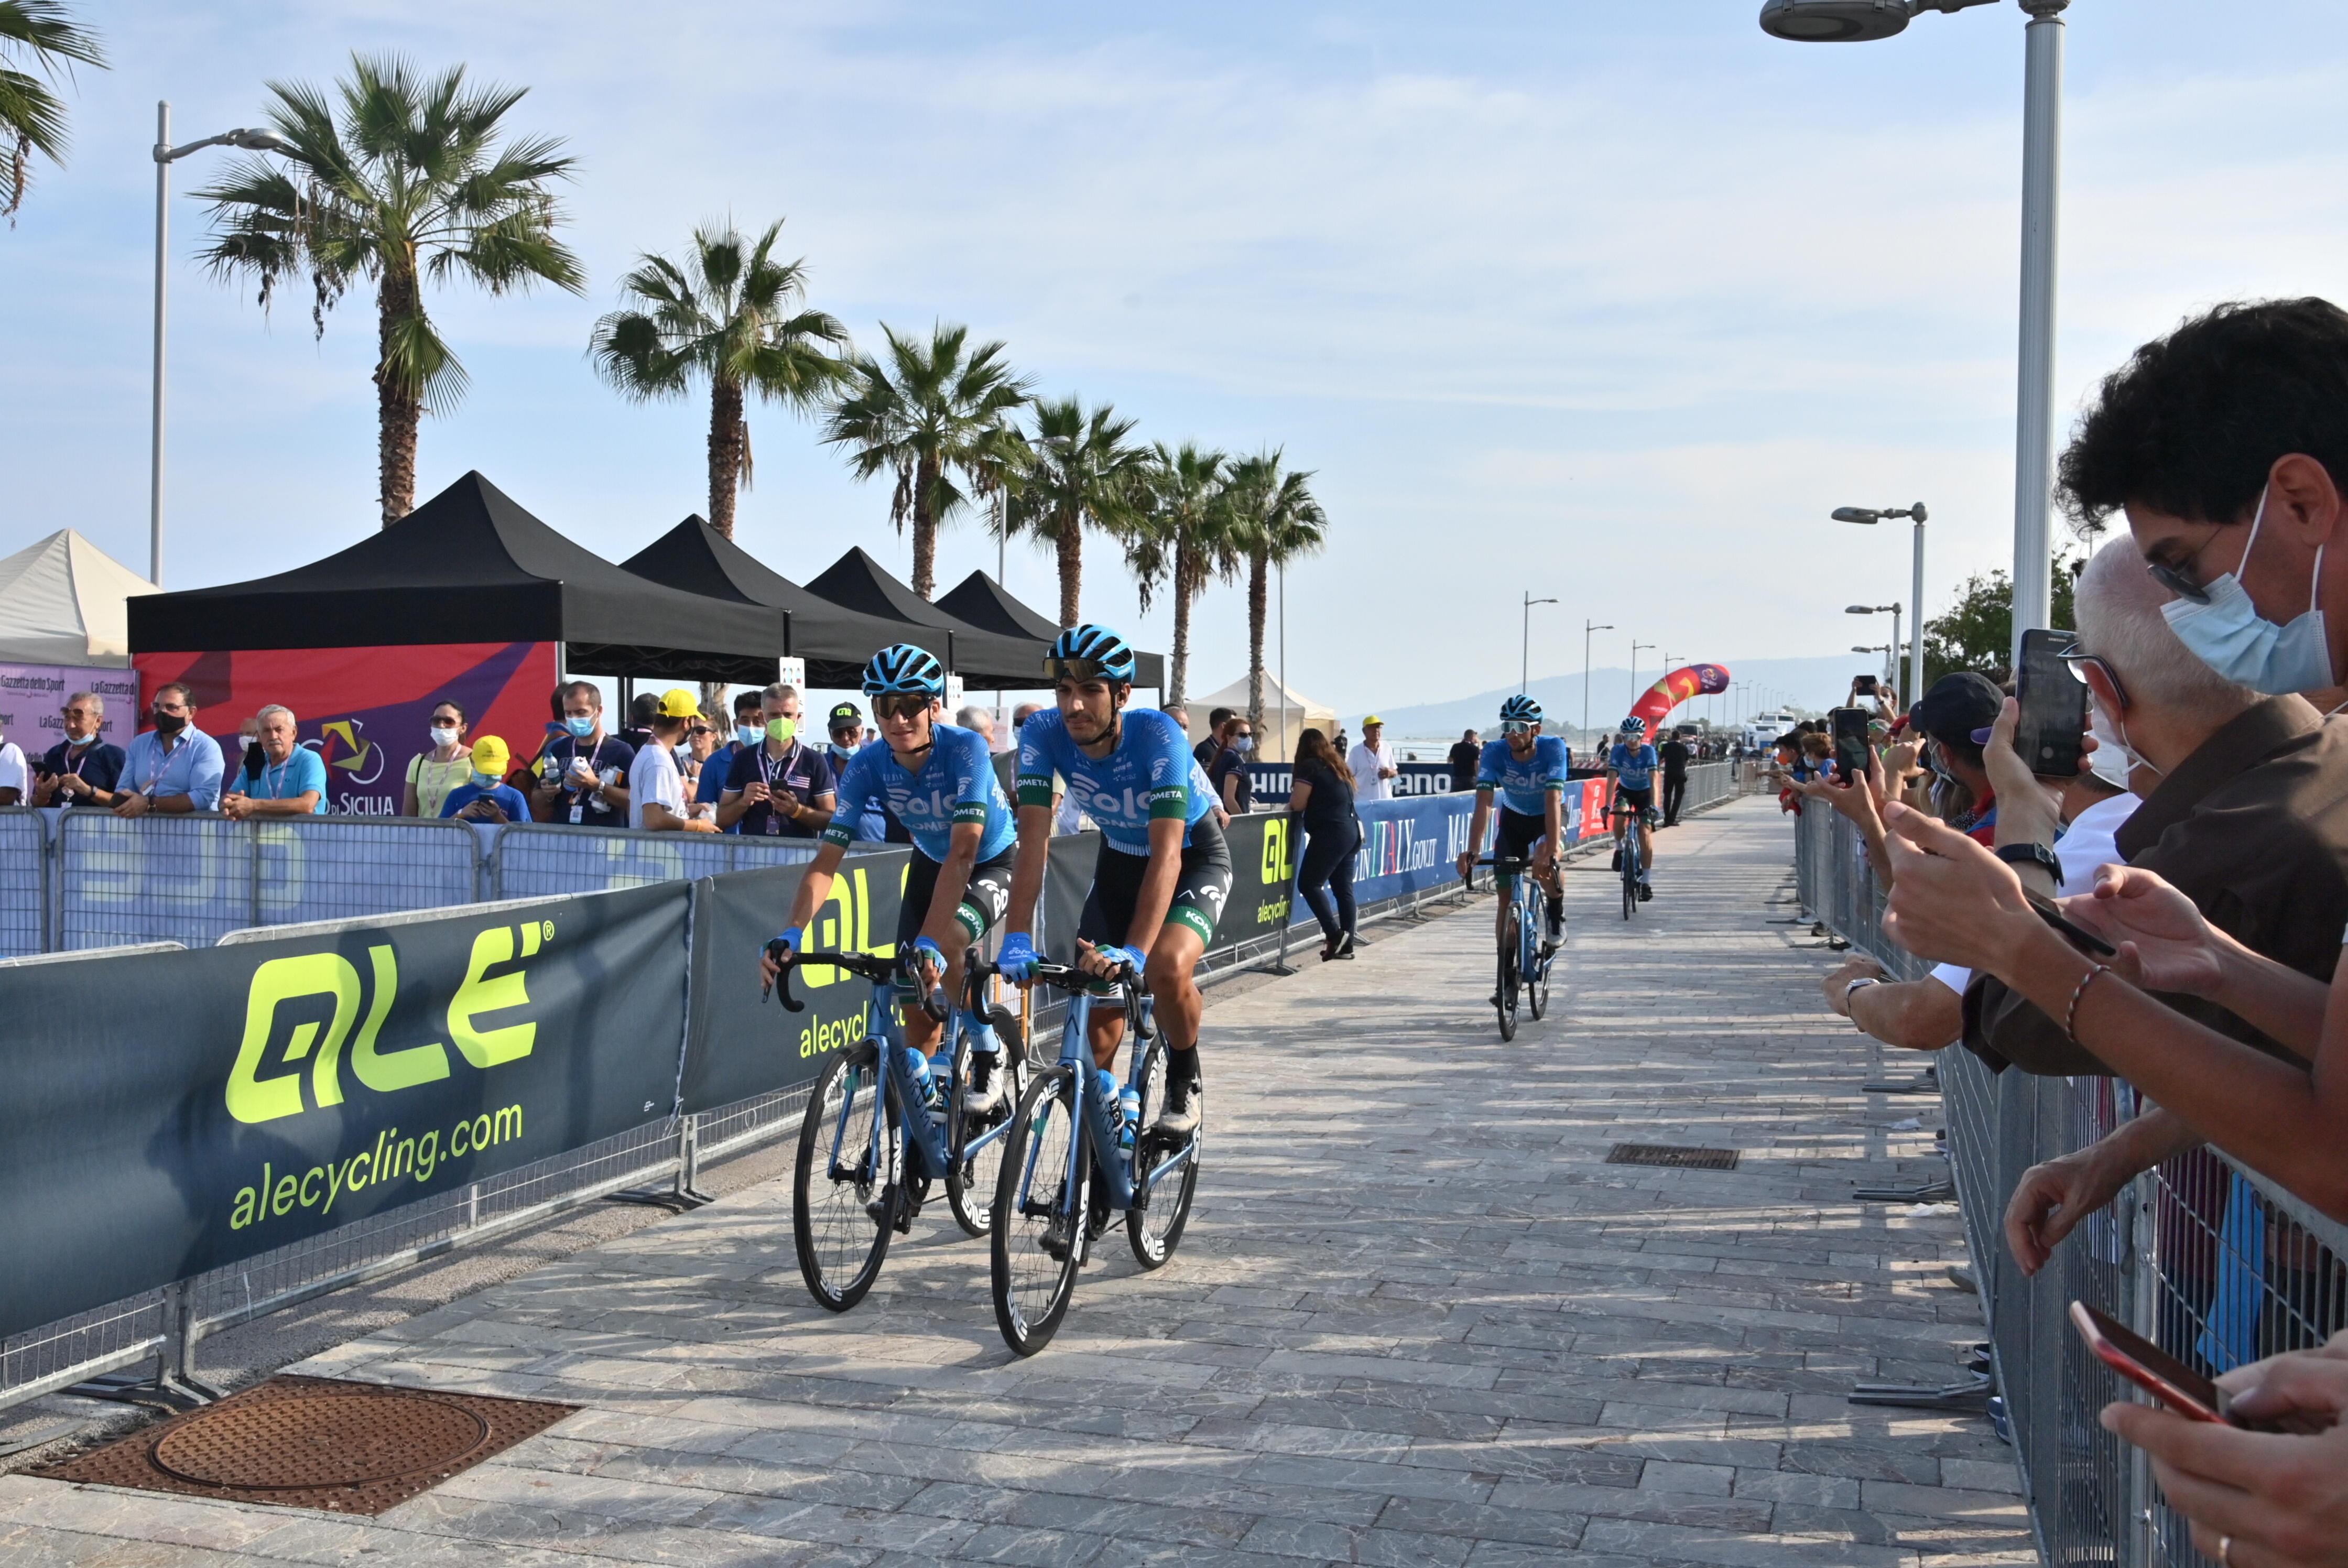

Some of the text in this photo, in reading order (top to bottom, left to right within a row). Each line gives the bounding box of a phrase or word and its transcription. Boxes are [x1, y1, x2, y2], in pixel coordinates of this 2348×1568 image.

[1, 675, 64, 693] Gazzetta dello Sport
[91, 682, 99, 693] La
[100, 681, 129, 695] Gazzetta
[39, 716, 47, 727] La
[48, 715, 63, 729] Gazz
[1017, 779, 1049, 788] OMETA
[341, 792, 395, 815] SICILIA
[824, 828, 849, 840] META
[1262, 818, 1293, 885] AL
[230, 1104, 523, 1231] alecycling.com
